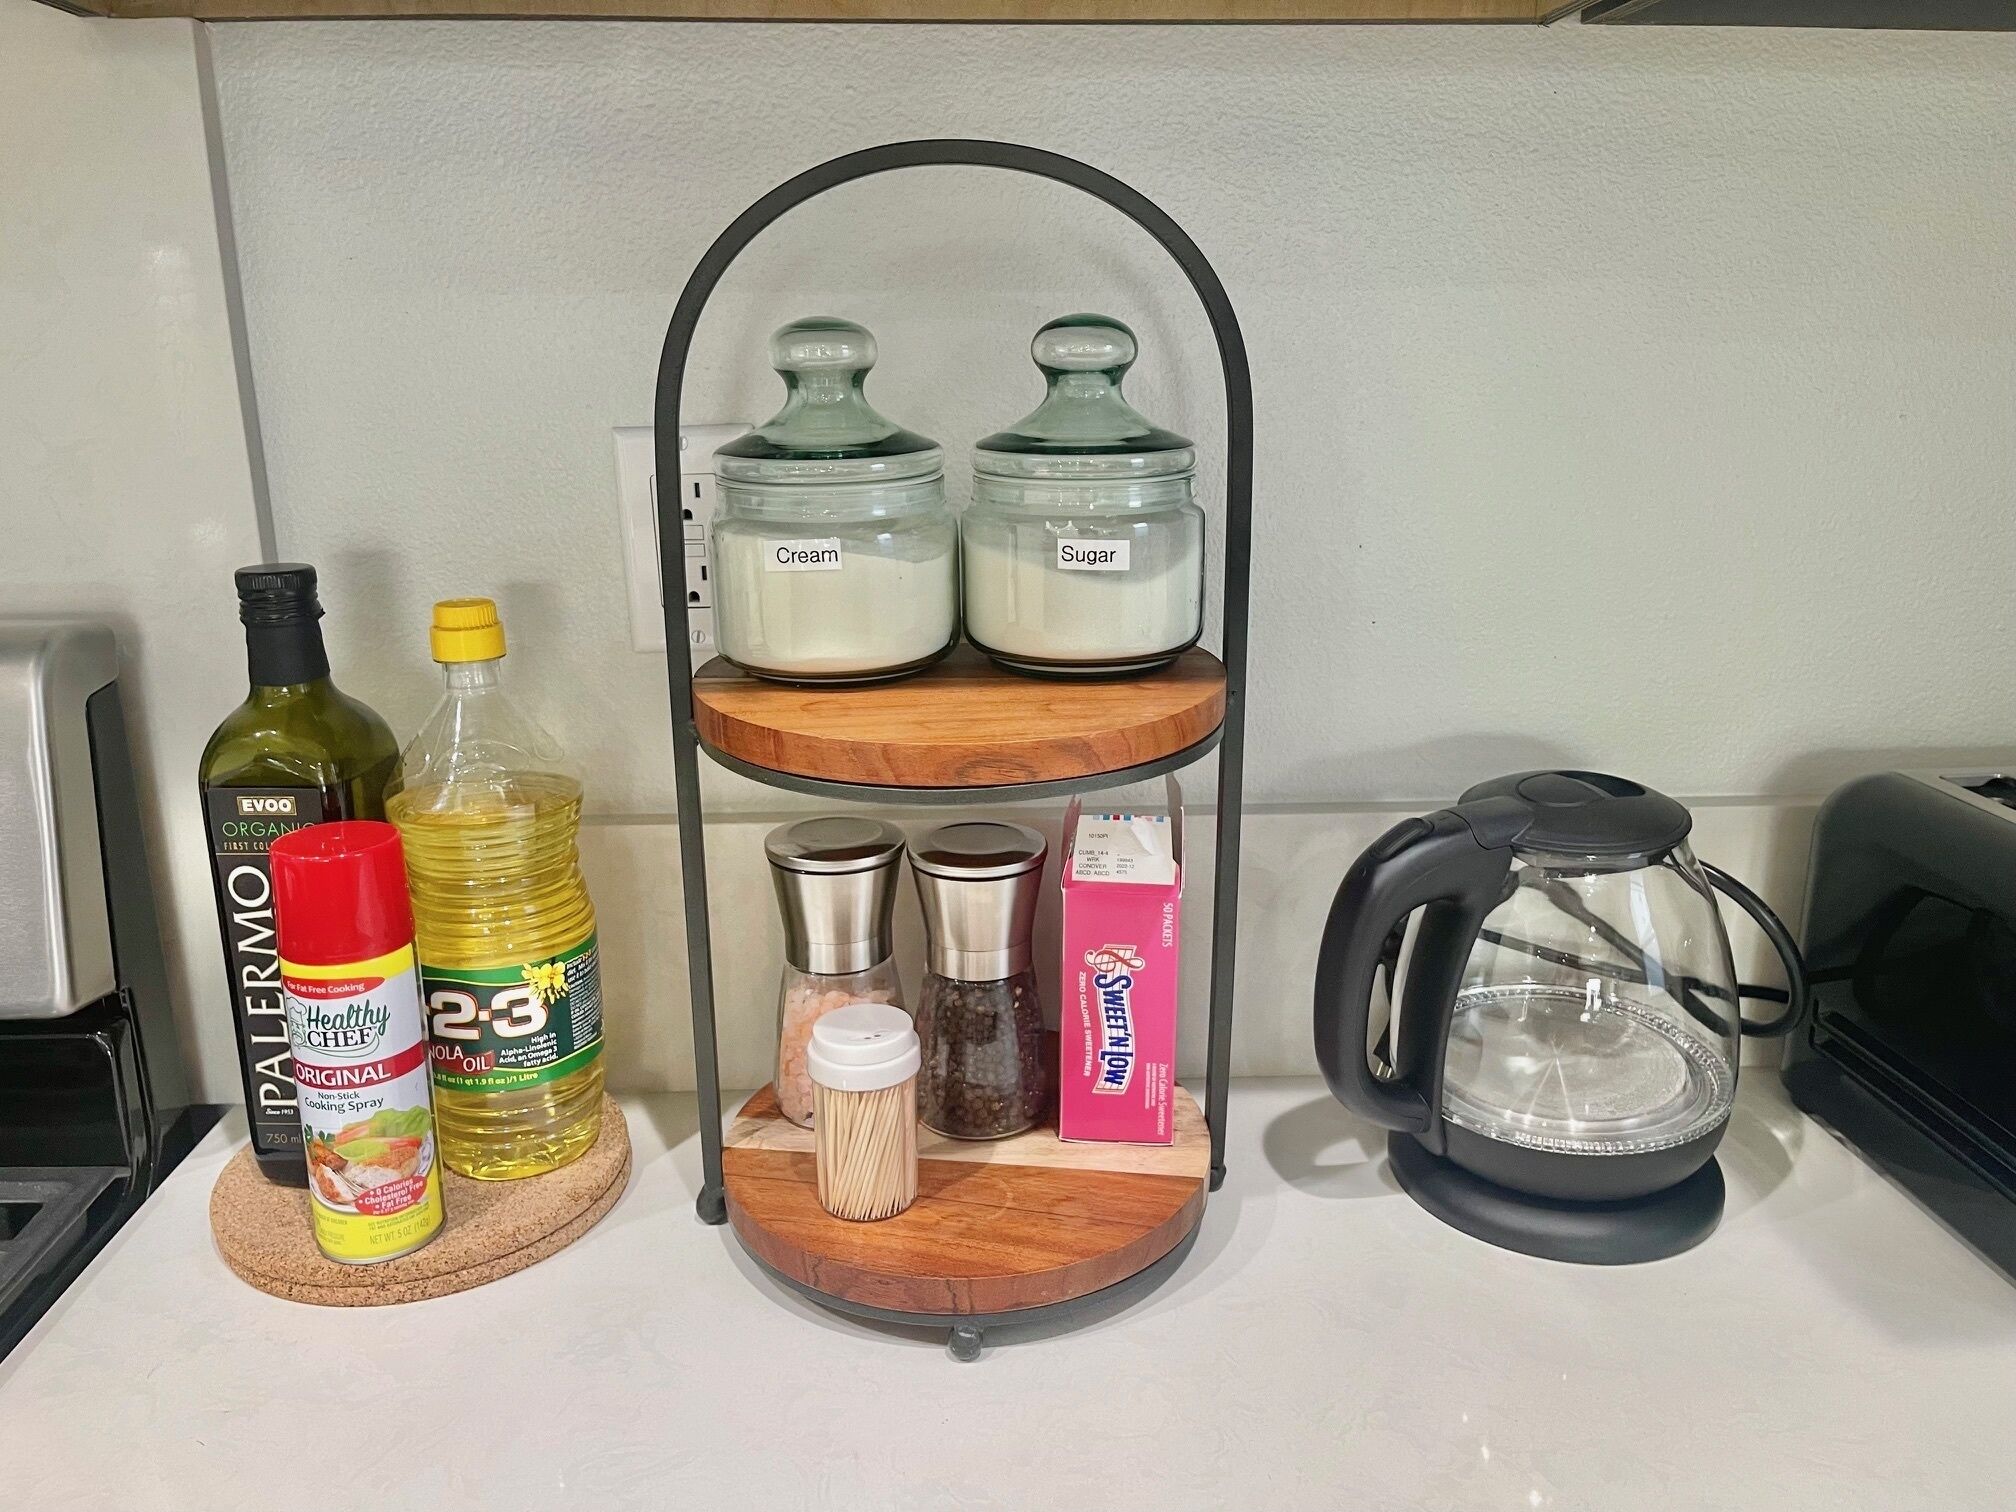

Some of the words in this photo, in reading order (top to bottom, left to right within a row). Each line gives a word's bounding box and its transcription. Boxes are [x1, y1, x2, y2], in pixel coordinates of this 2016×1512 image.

[776, 547, 839, 564] Cream
[1061, 545, 1116, 566] Sugar
[241, 798, 292, 812] EVOO
[223, 842, 249, 851] FIRST
[253, 842, 273, 851] COL
[1162, 902, 1173, 913] 50
[1161, 914, 1173, 947] PACKETS
[228, 865, 300, 1109] PALERMO
[286, 980, 297, 990] For
[297, 984, 307, 993] Fat
[308, 985, 326, 994] Free
[327, 983, 365, 994] Cooking
[1079, 971, 1087, 992] ZERO
[307, 999, 390, 1036] Healthy
[1079, 994, 1091, 1028] CALORIE
[307, 1027, 372, 1048] CHEF
[531, 1034, 549, 1044] High
[501, 1039, 558, 1056] Alpha-Linolenic
[527, 1049, 552, 1059] Omega
[1083, 1030, 1093, 1077] SWEETENER
[463, 1056, 490, 1072] OIL
[523, 1058, 541, 1067] fatty
[1100, 1051, 1133, 1085] LOW
[1159, 1063, 1169, 1077] Zero
[296, 1063, 392, 1086] ORIGINAL
[465, 1078, 473, 1086] qt
[475, 1078, 487, 1086] 1.9
[519, 1072, 538, 1081] Litre
[317, 1091, 360, 1100] Non-Stick
[1158, 1079, 1169, 1101] Calorie
[265, 1107, 281, 1115] Since
[304, 1096, 345, 1114] Cooking
[348, 1097, 384, 1112] Spray
[1157, 1101, 1168, 1136] Sweetener
[265, 1133, 288, 1144] 750
[364, 1187, 408, 1204] Cholesterol
[409, 1180, 424, 1191] Free
[383, 1178, 414, 1193] Calories
[381, 1201, 395, 1209] Fat
[395, 1194, 412, 1204] Free
[369, 1235, 382, 1244] NET
[397, 1229, 403, 1238] 5
